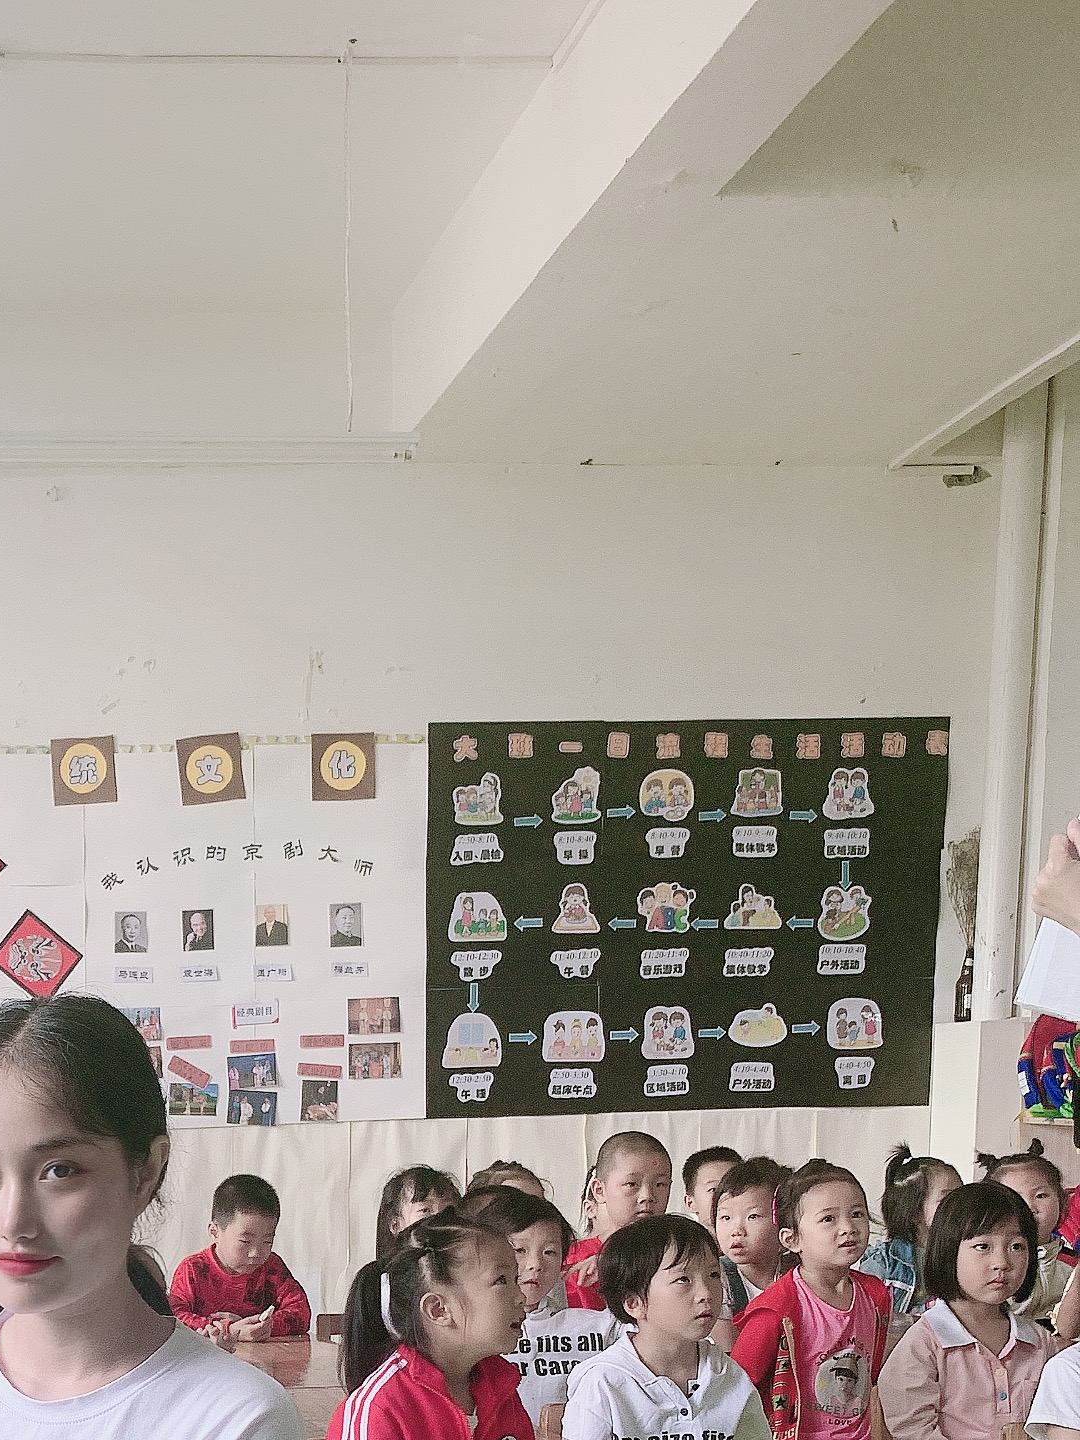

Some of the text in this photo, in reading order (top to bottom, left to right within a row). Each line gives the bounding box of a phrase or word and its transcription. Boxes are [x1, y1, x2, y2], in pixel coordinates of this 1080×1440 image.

[826, 844, 868, 856] 区域活动
[101, 840, 374, 891] 我认识的京剧大师
[648, 905, 688, 931] ABC
[642, 963, 684, 976] 音乐游戏
[819, 959, 860, 971] 户外活动
[236, 1006, 273, 1018] 经典剧目
[646, 1081, 687, 1094] 区域活动
[731, 1078, 772, 1090] 户外活动
[536, 1334, 572, 1352] fits
[577, 1332, 604, 1351] all
[828, 1418, 852, 1426] LOVE
